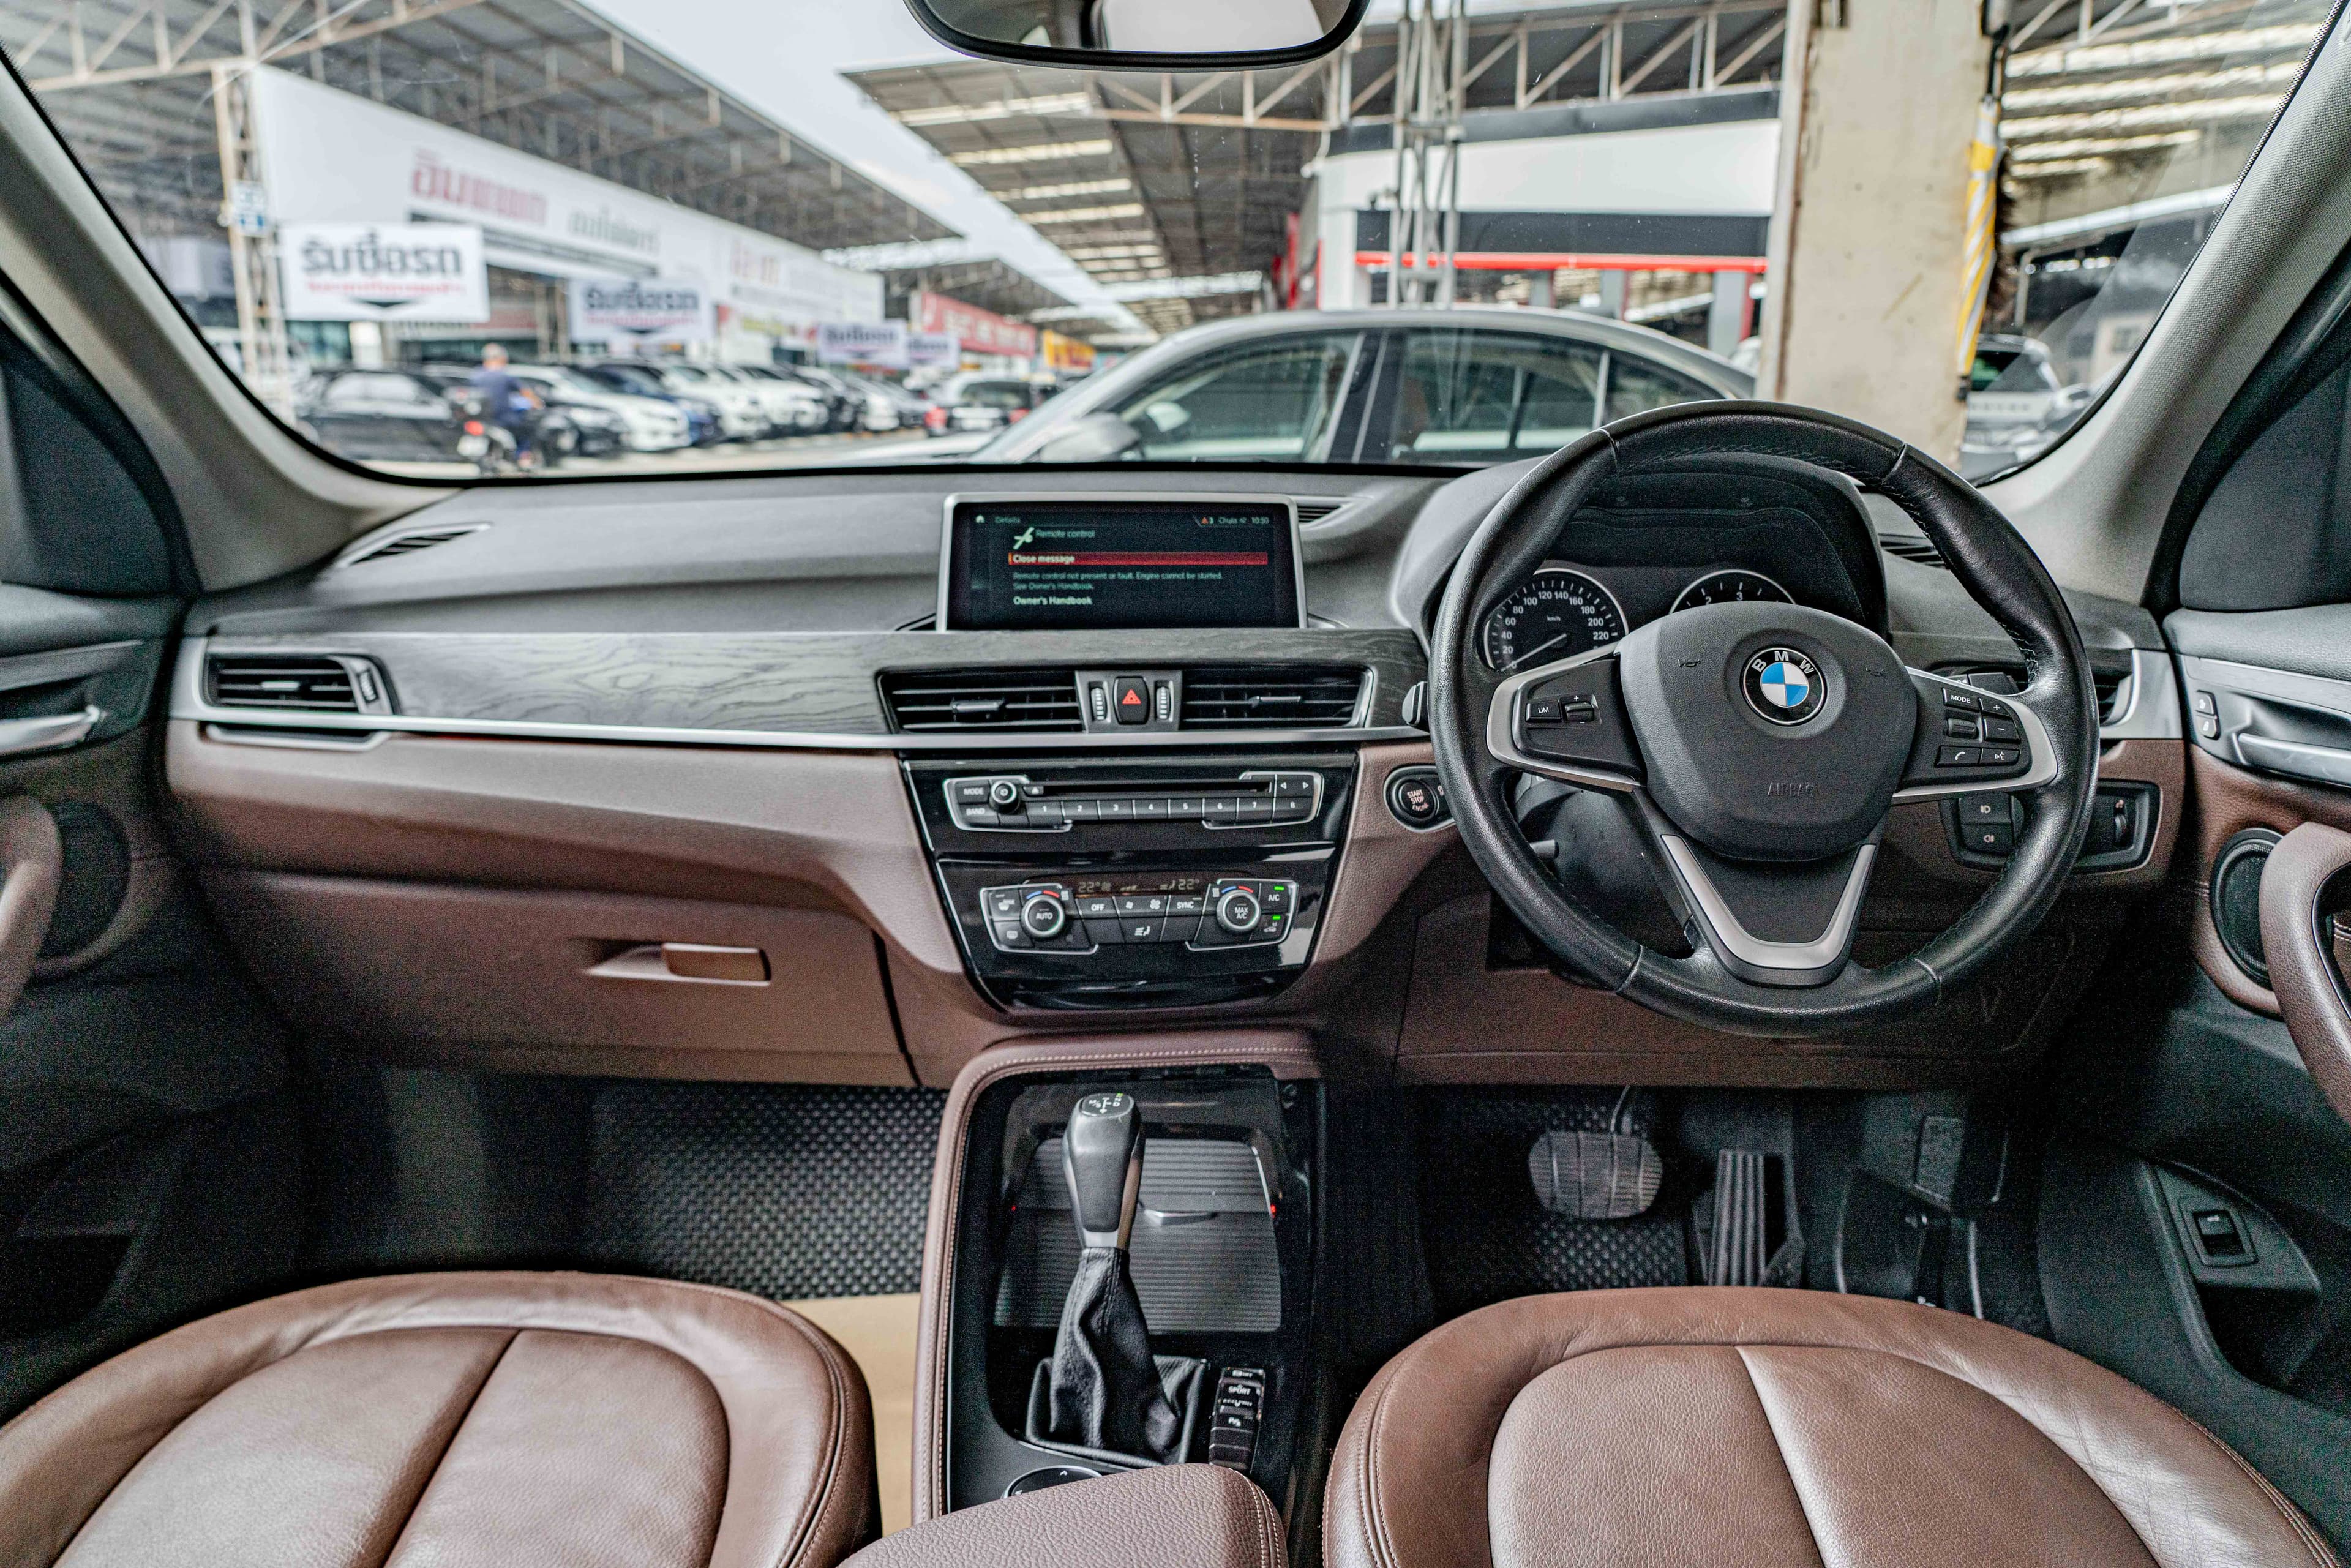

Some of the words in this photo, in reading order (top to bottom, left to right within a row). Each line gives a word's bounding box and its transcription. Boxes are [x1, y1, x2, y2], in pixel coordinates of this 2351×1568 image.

[1013, 554, 1037, 563] Close
[1038, 555, 1075, 565] message
[1136, 572, 1160, 580] Engine
[1554, 591, 1569, 599] 140
[1736, 591, 1743, 601] 3
[1013, 596, 1048, 605] Owner's
[1049, 596, 1092, 605] Handbook
[1523, 597, 1537, 606] 100
[1569, 597, 1583, 606] 160
[1705, 596, 1712, 605] 2
[1581, 606, 1595, 615] 180
[1505, 617, 1516, 626] 60
[1588, 618, 1604, 627] 200
[1501, 631, 1512, 640] 40
[1593, 631, 1609, 640] 220
[1502, 646, 1513, 655] 20
[1751, 651, 1815, 674] BMW
[1951, 694, 1971, 703] MODE
[1407, 789, 1423, 799] START
[1767, 782, 1813, 797] AIRBAG
[1411, 795, 1425, 805] STOP
[1228, 1386, 1251, 1395] SPORT
